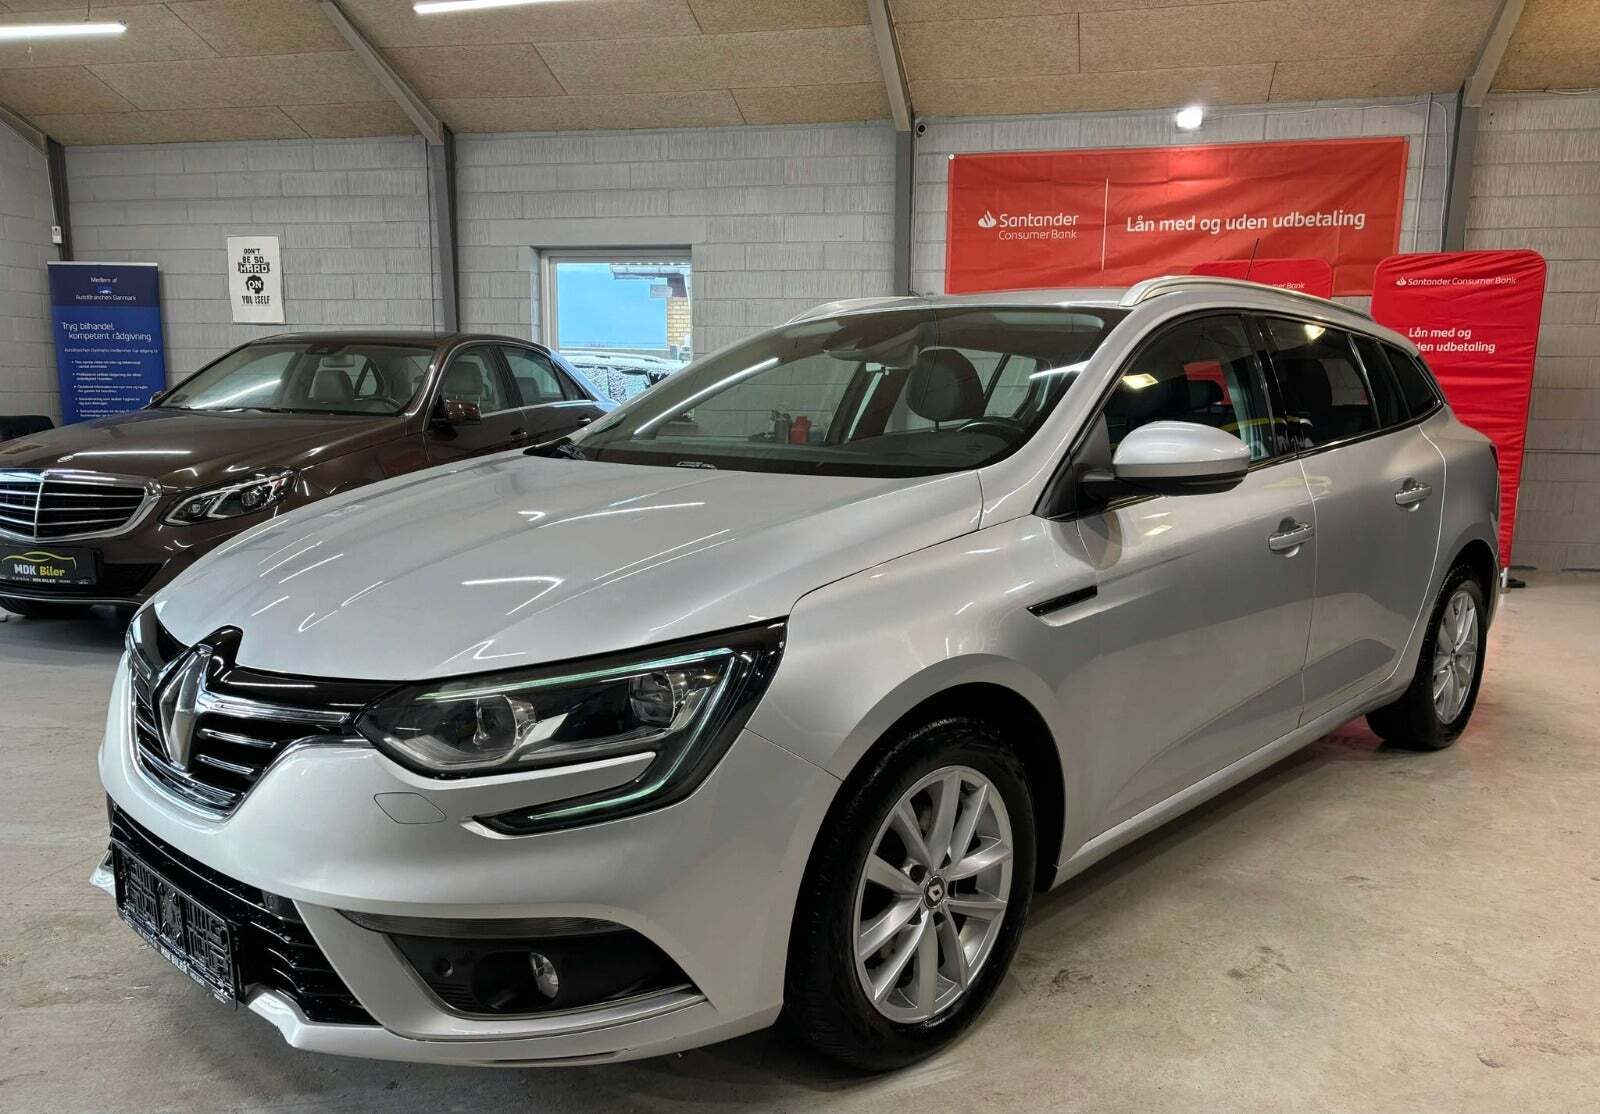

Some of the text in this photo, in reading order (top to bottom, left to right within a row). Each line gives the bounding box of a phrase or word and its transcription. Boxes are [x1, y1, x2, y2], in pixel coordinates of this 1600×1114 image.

[999, 213, 1079, 228] Santander
[1126, 209, 1366, 234] Lån med og uden udbetaling
[998, 229, 1077, 240] Consumer Bank
[242, 256, 264, 264] BE SO
[240, 264, 268, 273] HARD
[248, 280, 262, 289] ON
[1286, 281, 1305, 289] Bank
[1407, 275, 1517, 286] Santander Consumer Bank
[62, 322, 115, 332] Tryg bilhandel,
[69, 332, 152, 342] kompetent rådgivning
[1408, 326, 1472, 340] Lån med og
[1415, 341, 1496, 353] den udbetaling
[14, 563, 65, 577] MDK Biler
